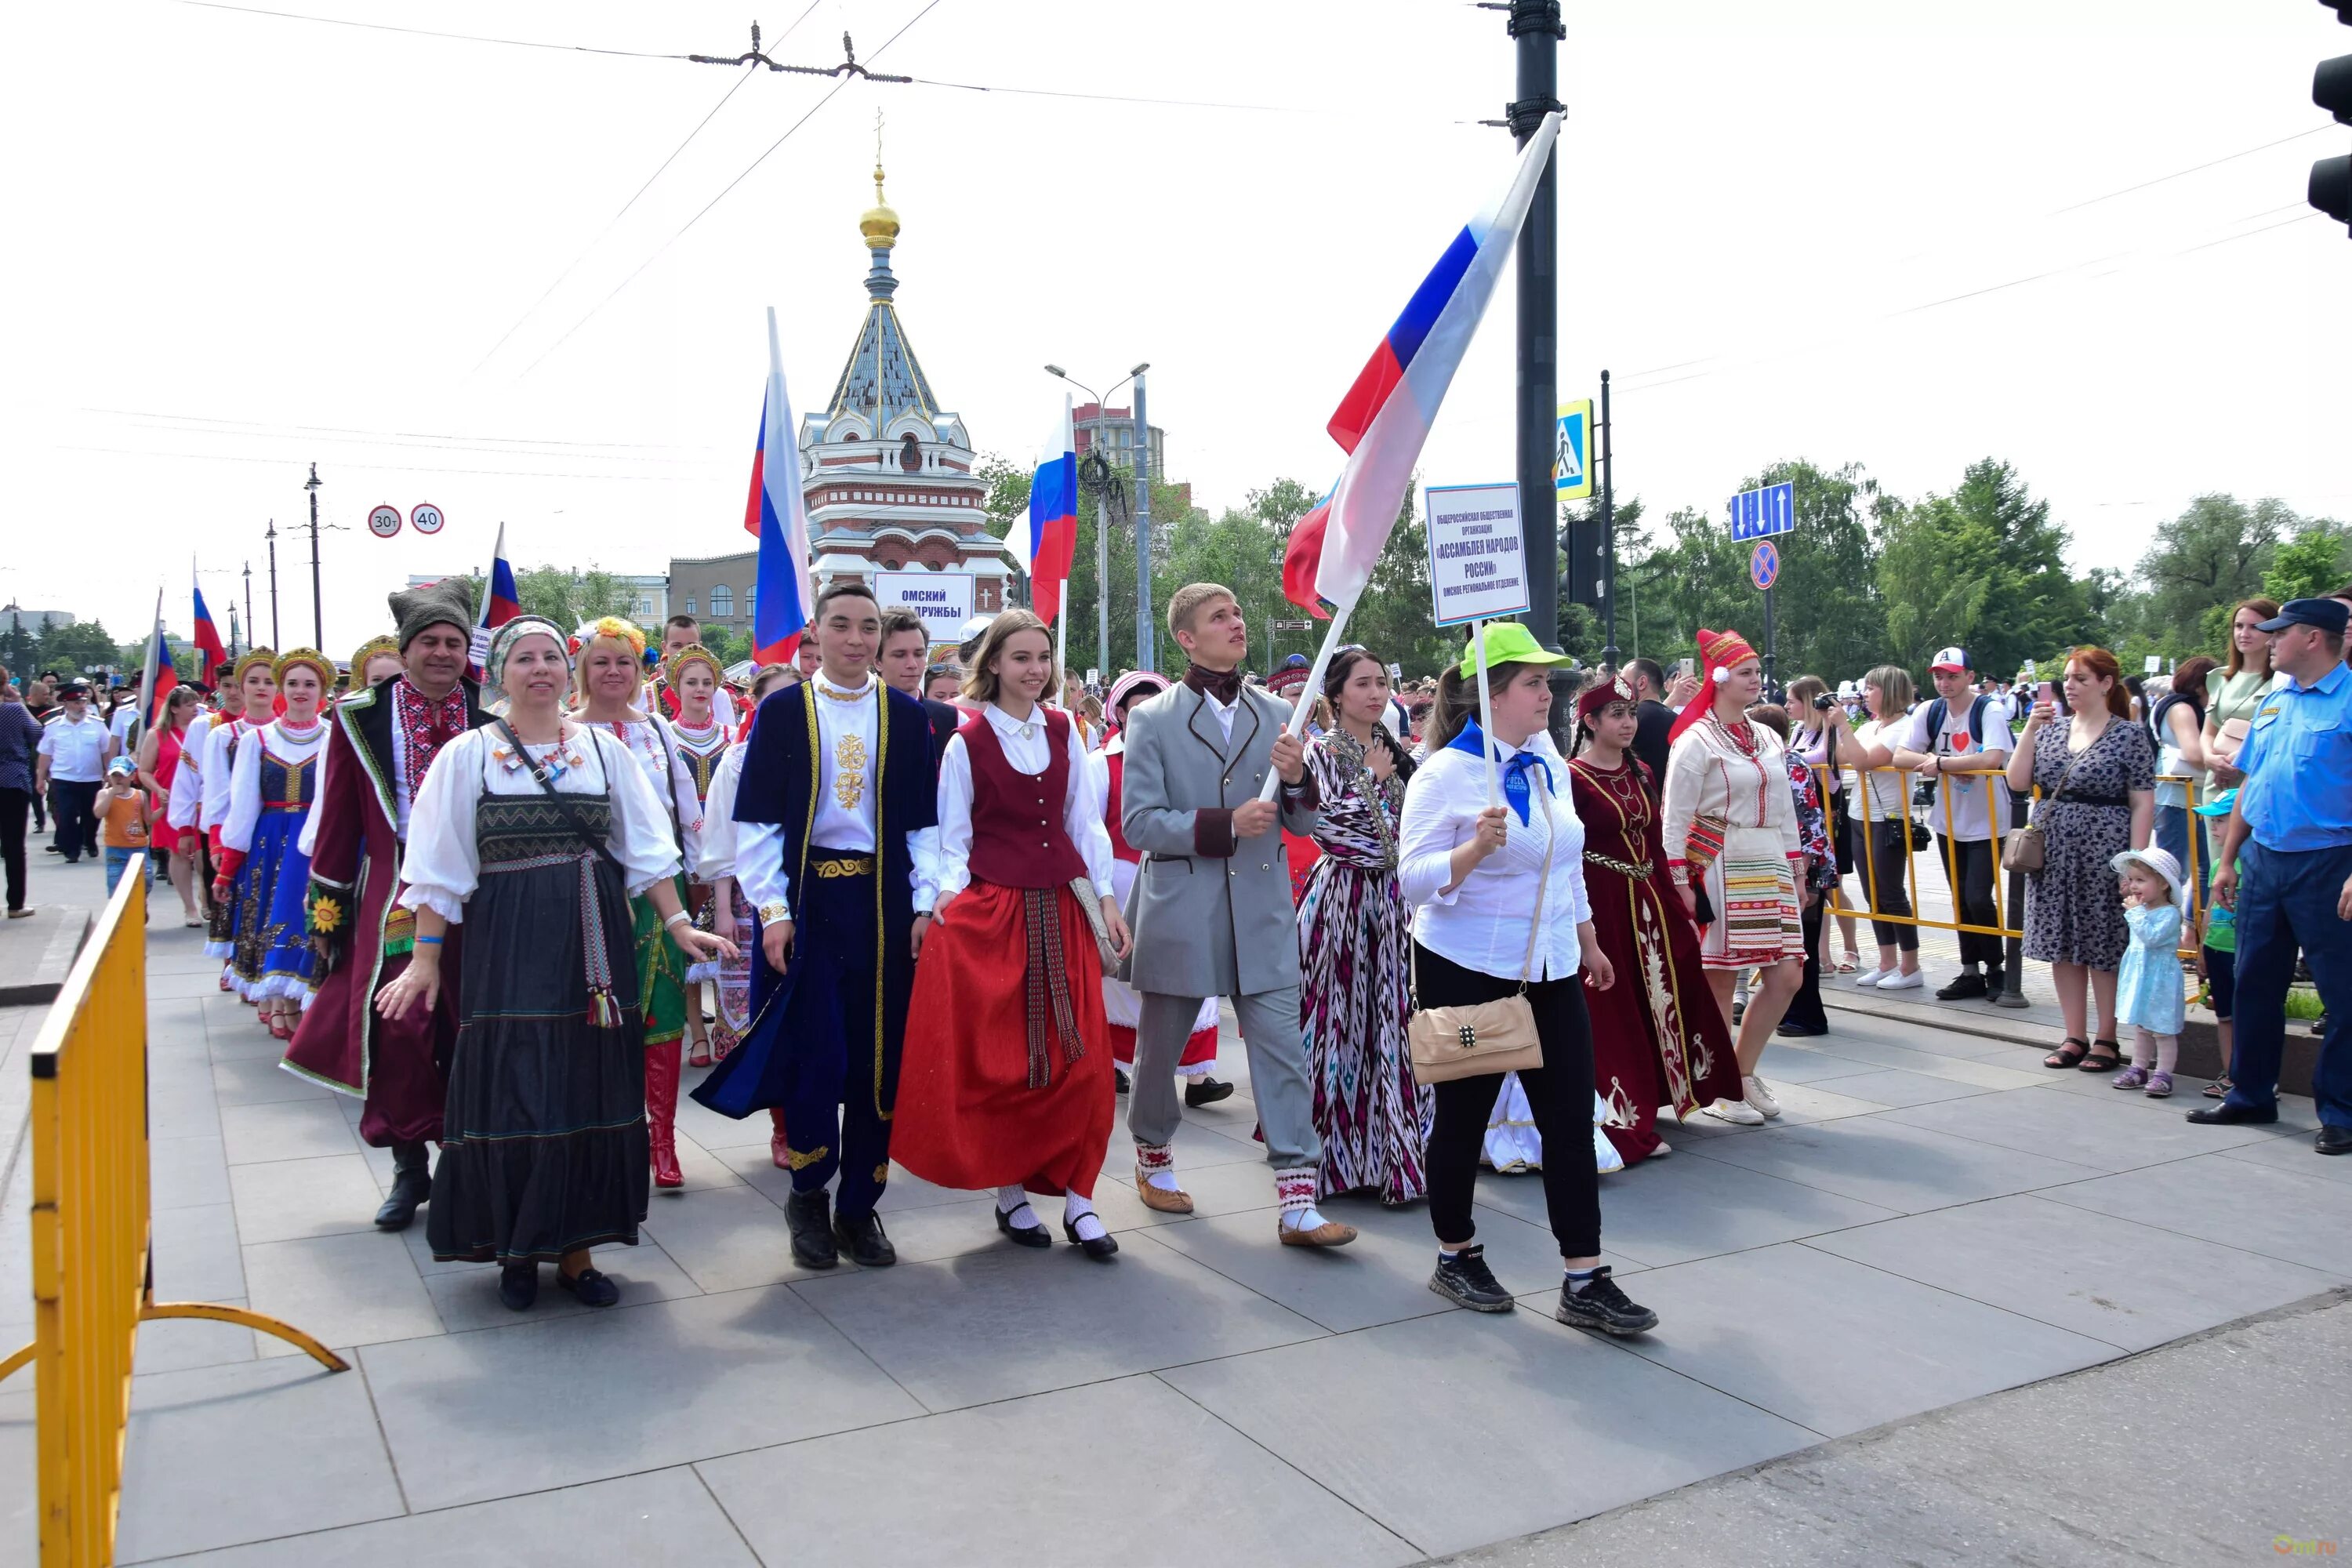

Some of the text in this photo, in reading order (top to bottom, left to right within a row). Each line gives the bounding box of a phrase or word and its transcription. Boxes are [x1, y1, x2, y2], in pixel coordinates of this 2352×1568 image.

[417, 512, 437, 525] 40
[1436, 509, 1513, 525] ОБЩЕРОССИЙСКАЯ ОБЩЕСТВЕННАЯ
[1461, 524, 1493, 536] ОРГАНИЗАЦИЯ
[1436, 536, 1519, 559] «АССАМБЛЕЯ НАРОДОВ
[1464, 560, 1497, 579] РОССИИ»
[1443, 577, 1519, 597] ОМСКОЕ РЕГИОНАЛЬНОЕ ОТДЕЛЕНИЕ
[902, 589, 946, 602] ОМСКИЙ
[1939, 651, 1951, 662] A
[1940, 731, 1951, 753] I
